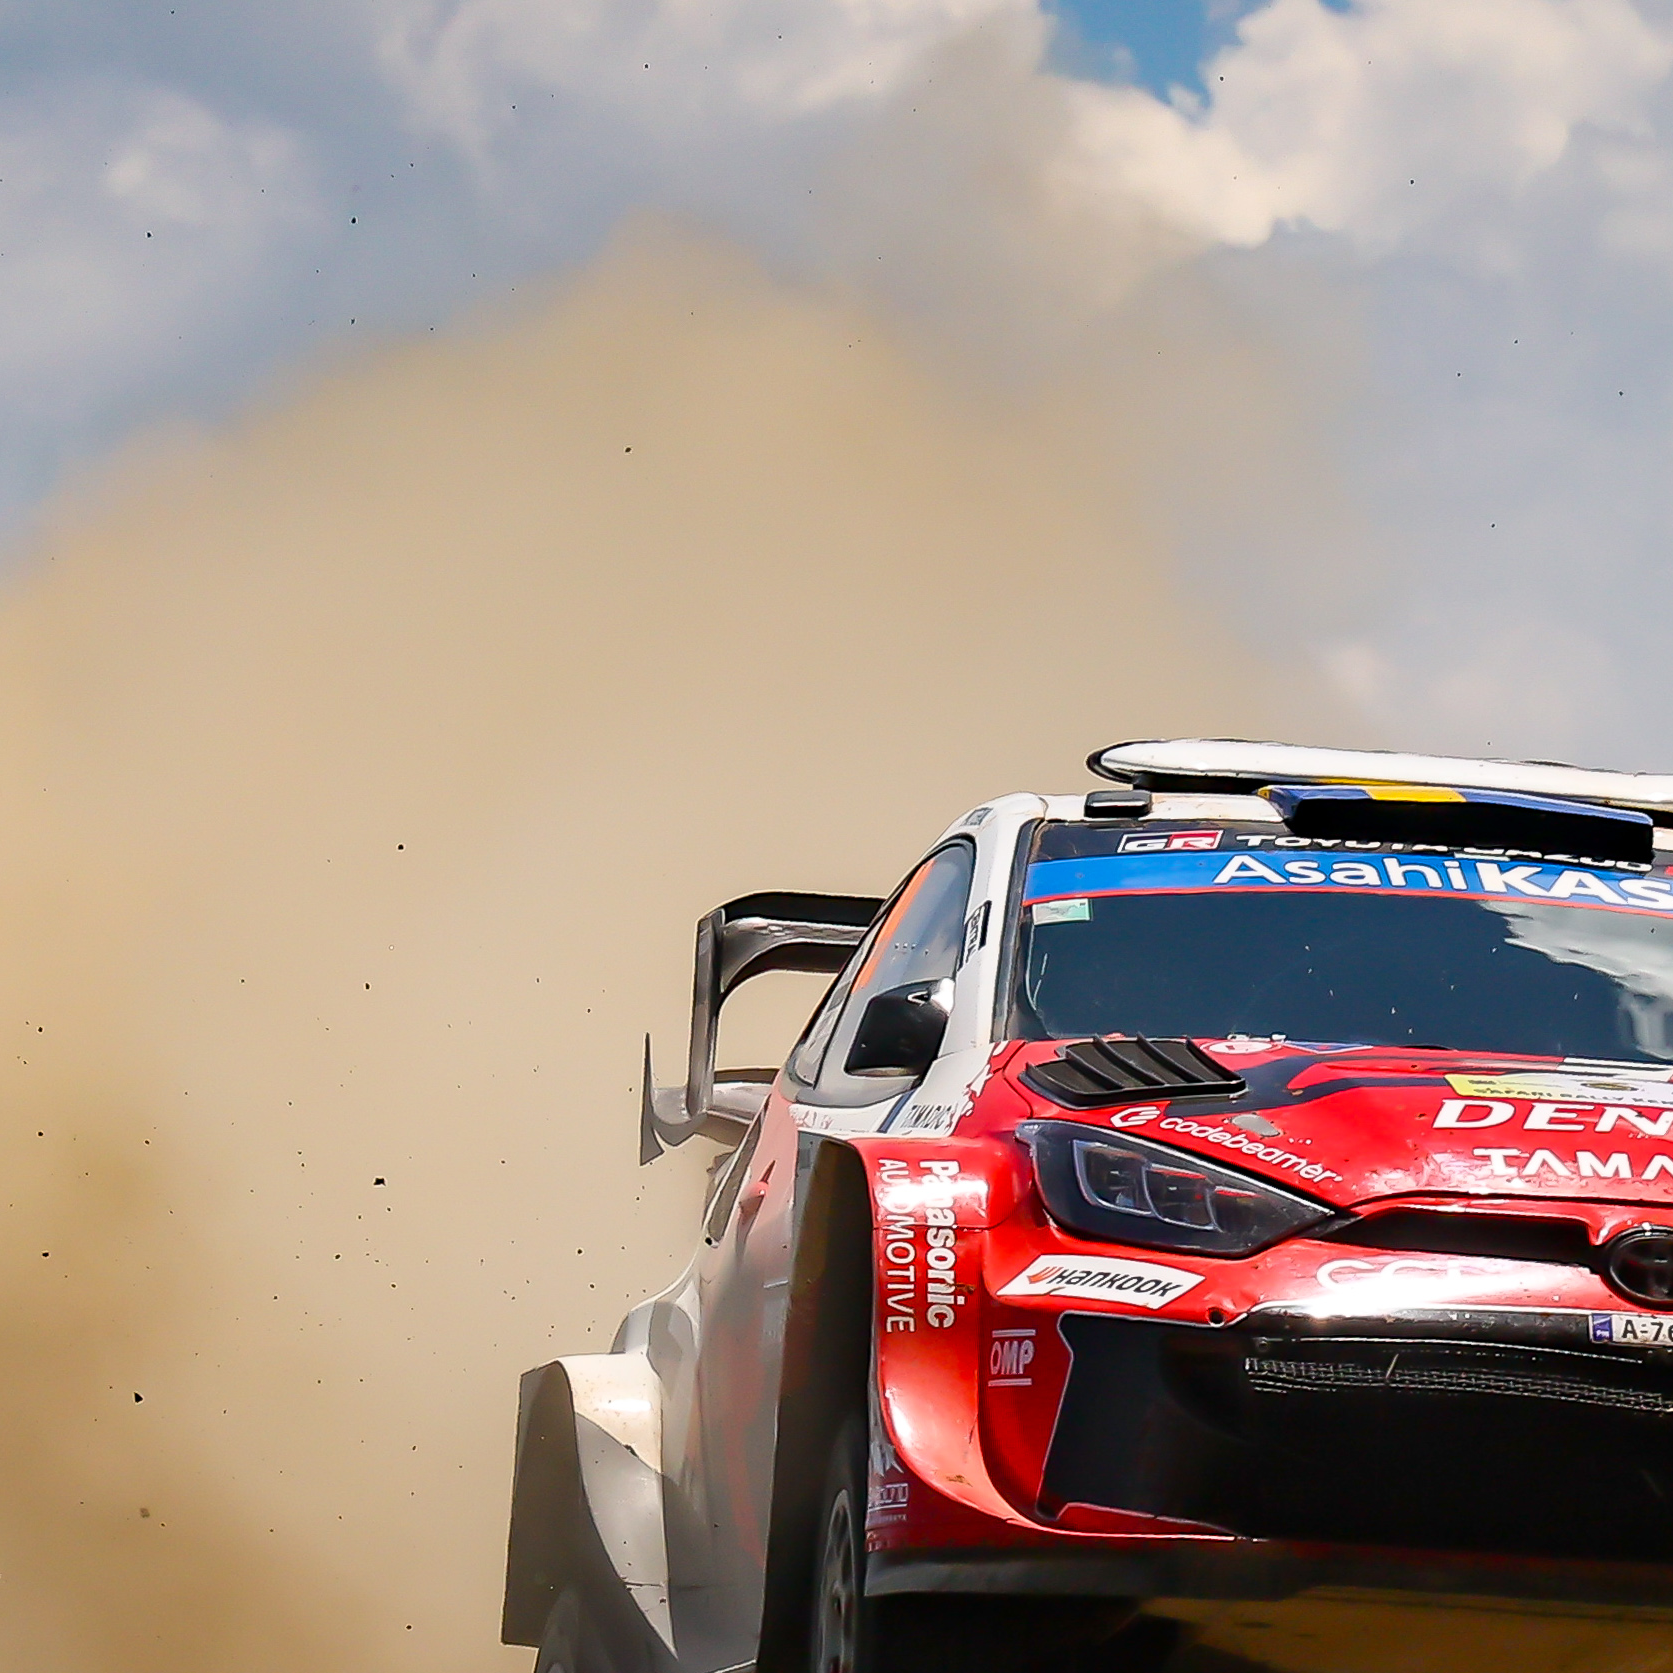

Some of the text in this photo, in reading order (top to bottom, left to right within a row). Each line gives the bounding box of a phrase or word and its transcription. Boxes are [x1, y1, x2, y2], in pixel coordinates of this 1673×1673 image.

[1159, 1115, 1341, 1183] codebeamer
[878, 1158, 916, 1333] AUOMOTIVE
[990, 1339, 1035, 1375] OMP
